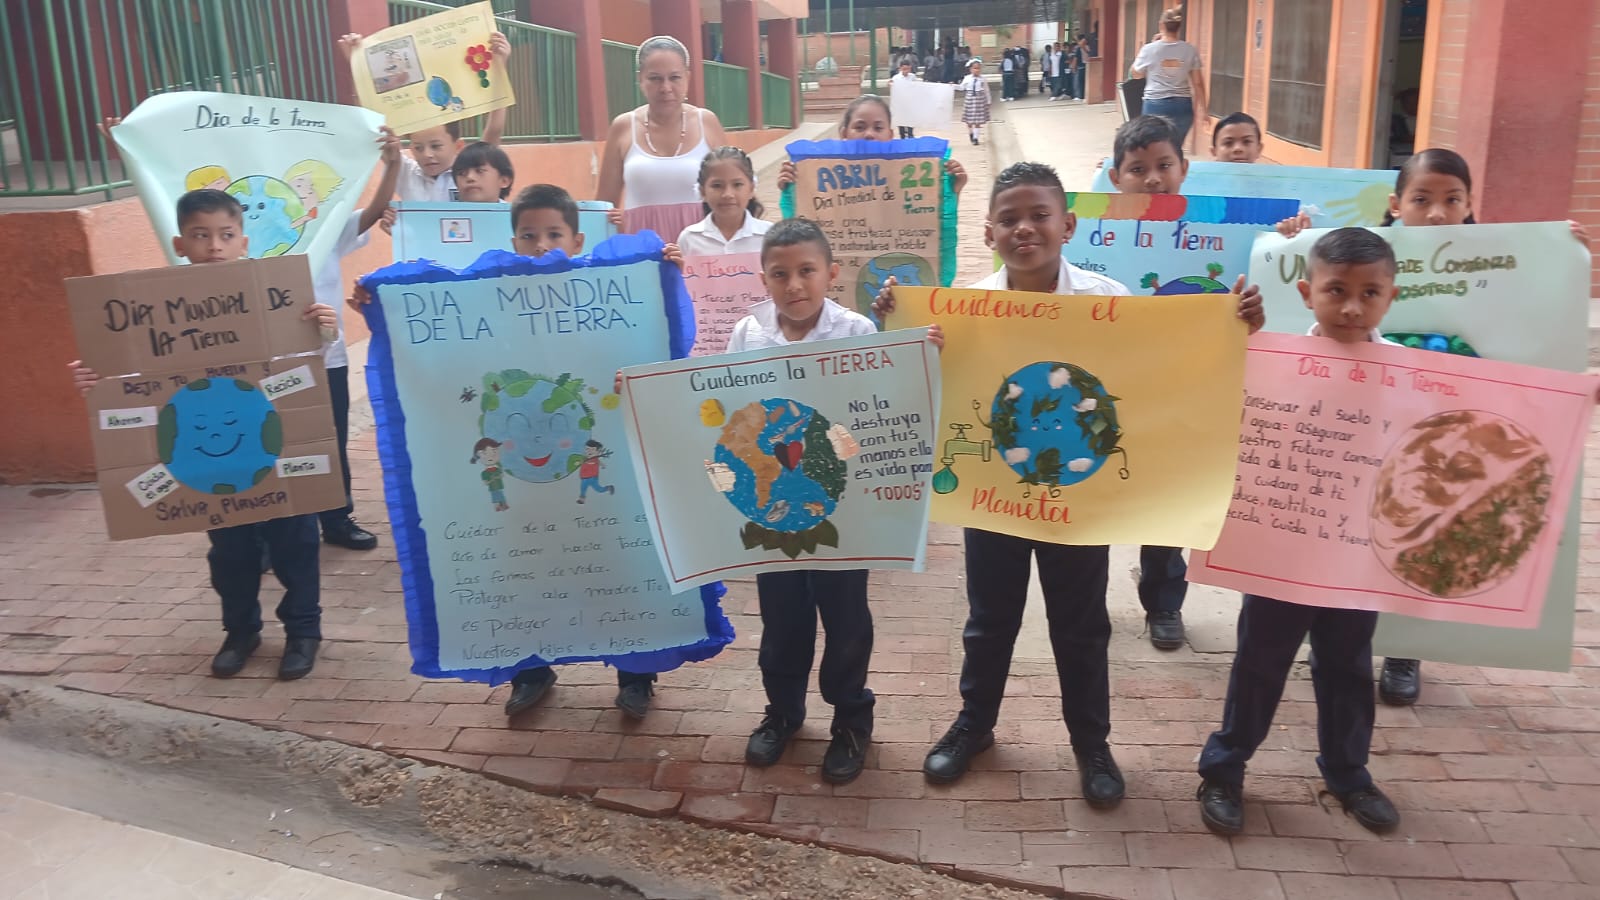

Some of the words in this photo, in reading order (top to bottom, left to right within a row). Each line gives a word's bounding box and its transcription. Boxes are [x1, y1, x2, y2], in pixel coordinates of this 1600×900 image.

[242, 106, 260, 125] de
[817, 164, 887, 192] ABRIL
[900, 161, 935, 188] 22
[882, 186, 896, 201] de
[1089, 219, 1116, 247] de
[1135, 220, 1153, 248] la
[267, 287, 294, 311] DE
[402, 290, 461, 319] DIA
[496, 276, 643, 312] MUNDIAL
[929, 287, 1064, 321] Cuidemos
[1091, 296, 1120, 323] el
[408, 318, 447, 344] DE
[456, 316, 494, 340] LA
[517, 307, 637, 336] TIERRA.
[690, 366, 777, 391] Cuidemos
[786, 360, 805, 380] la
[1348, 362, 1367, 383] de
[1380, 365, 1396, 388] la
[1406, 369, 1459, 397] Tierra
[123, 381, 162, 396] DEJA
[848, 400, 868, 413] No
[873, 394, 889, 410] la
[1309, 400, 1322, 416] el
[851, 412, 921, 430] destruya
[860, 435, 886, 447] con
[889, 428, 919, 442] tus
[1239, 432, 1281, 449] uestro
[1295, 422, 1356, 442] asegurar
[859, 448, 905, 463] manos
[855, 468, 872, 479] es
[876, 461, 907, 476] vida
[1268, 452, 1281, 469] de
[1287, 456, 1298, 472] la
[1304, 458, 1343, 480] tierra
[1309, 478, 1325, 496] de
[972, 487, 1072, 525] Planeta
[1267, 494, 1327, 518] reutiliza
[444, 521, 504, 540] Cuidar
[522, 522, 537, 533] de
[574, 516, 618, 528] Tierra
[1318, 526, 1329, 540] la
[480, 548, 497, 560] de
[508, 548, 544, 557] amor
[562, 542, 602, 552] hacia
[491, 570, 535, 582] formas
[548, 567, 565, 577] de
[449, 589, 518, 609] Proteger
[584, 584, 639, 597] madre
[462, 620, 479, 631] es
[569, 610, 583, 626] el
[598, 608, 656, 626] futuro
[671, 603, 690, 617] de
[463, 643, 520, 660] Nuestros
